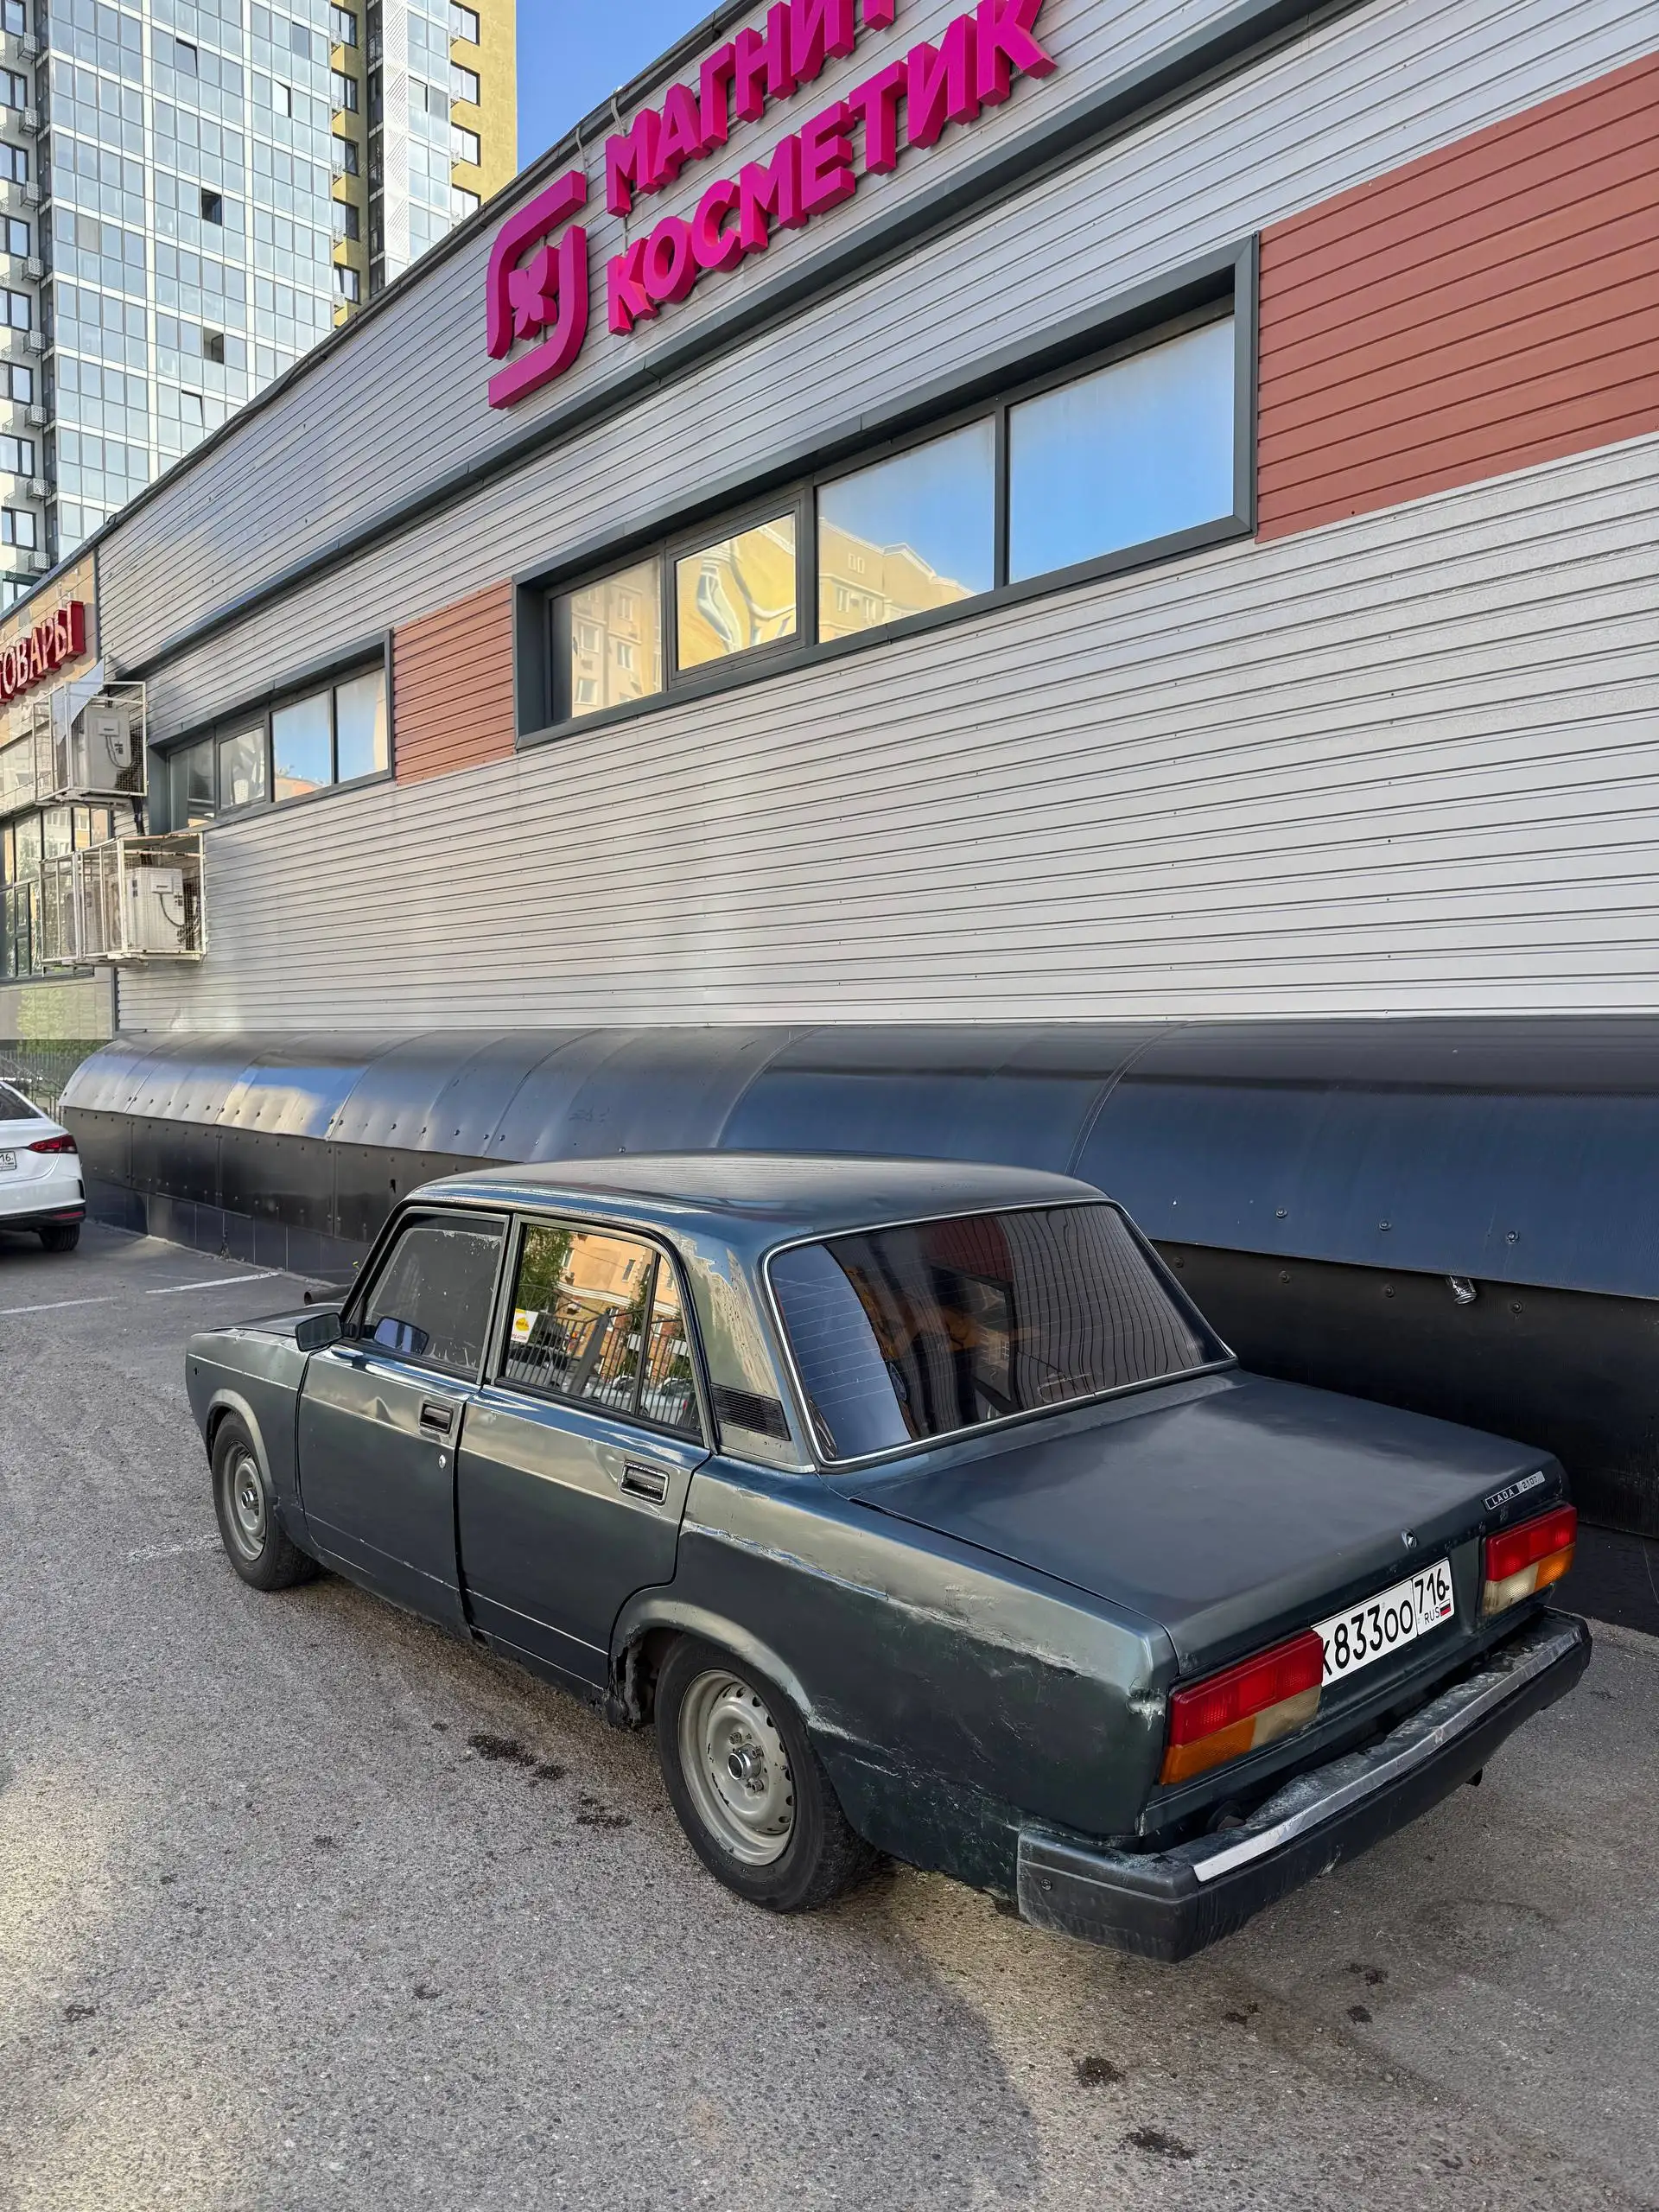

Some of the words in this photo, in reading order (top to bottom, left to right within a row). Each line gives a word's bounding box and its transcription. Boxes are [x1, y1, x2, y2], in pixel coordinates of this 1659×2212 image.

[607, 0, 1057, 335] КОСМЕТИК
[0, 601, 84, 702] ОВАРЫ
[1491, 1488, 1515, 1505] LADA
[1414, 1568, 1446, 1614] 716
[1424, 1606, 1440, 1624] RUS
